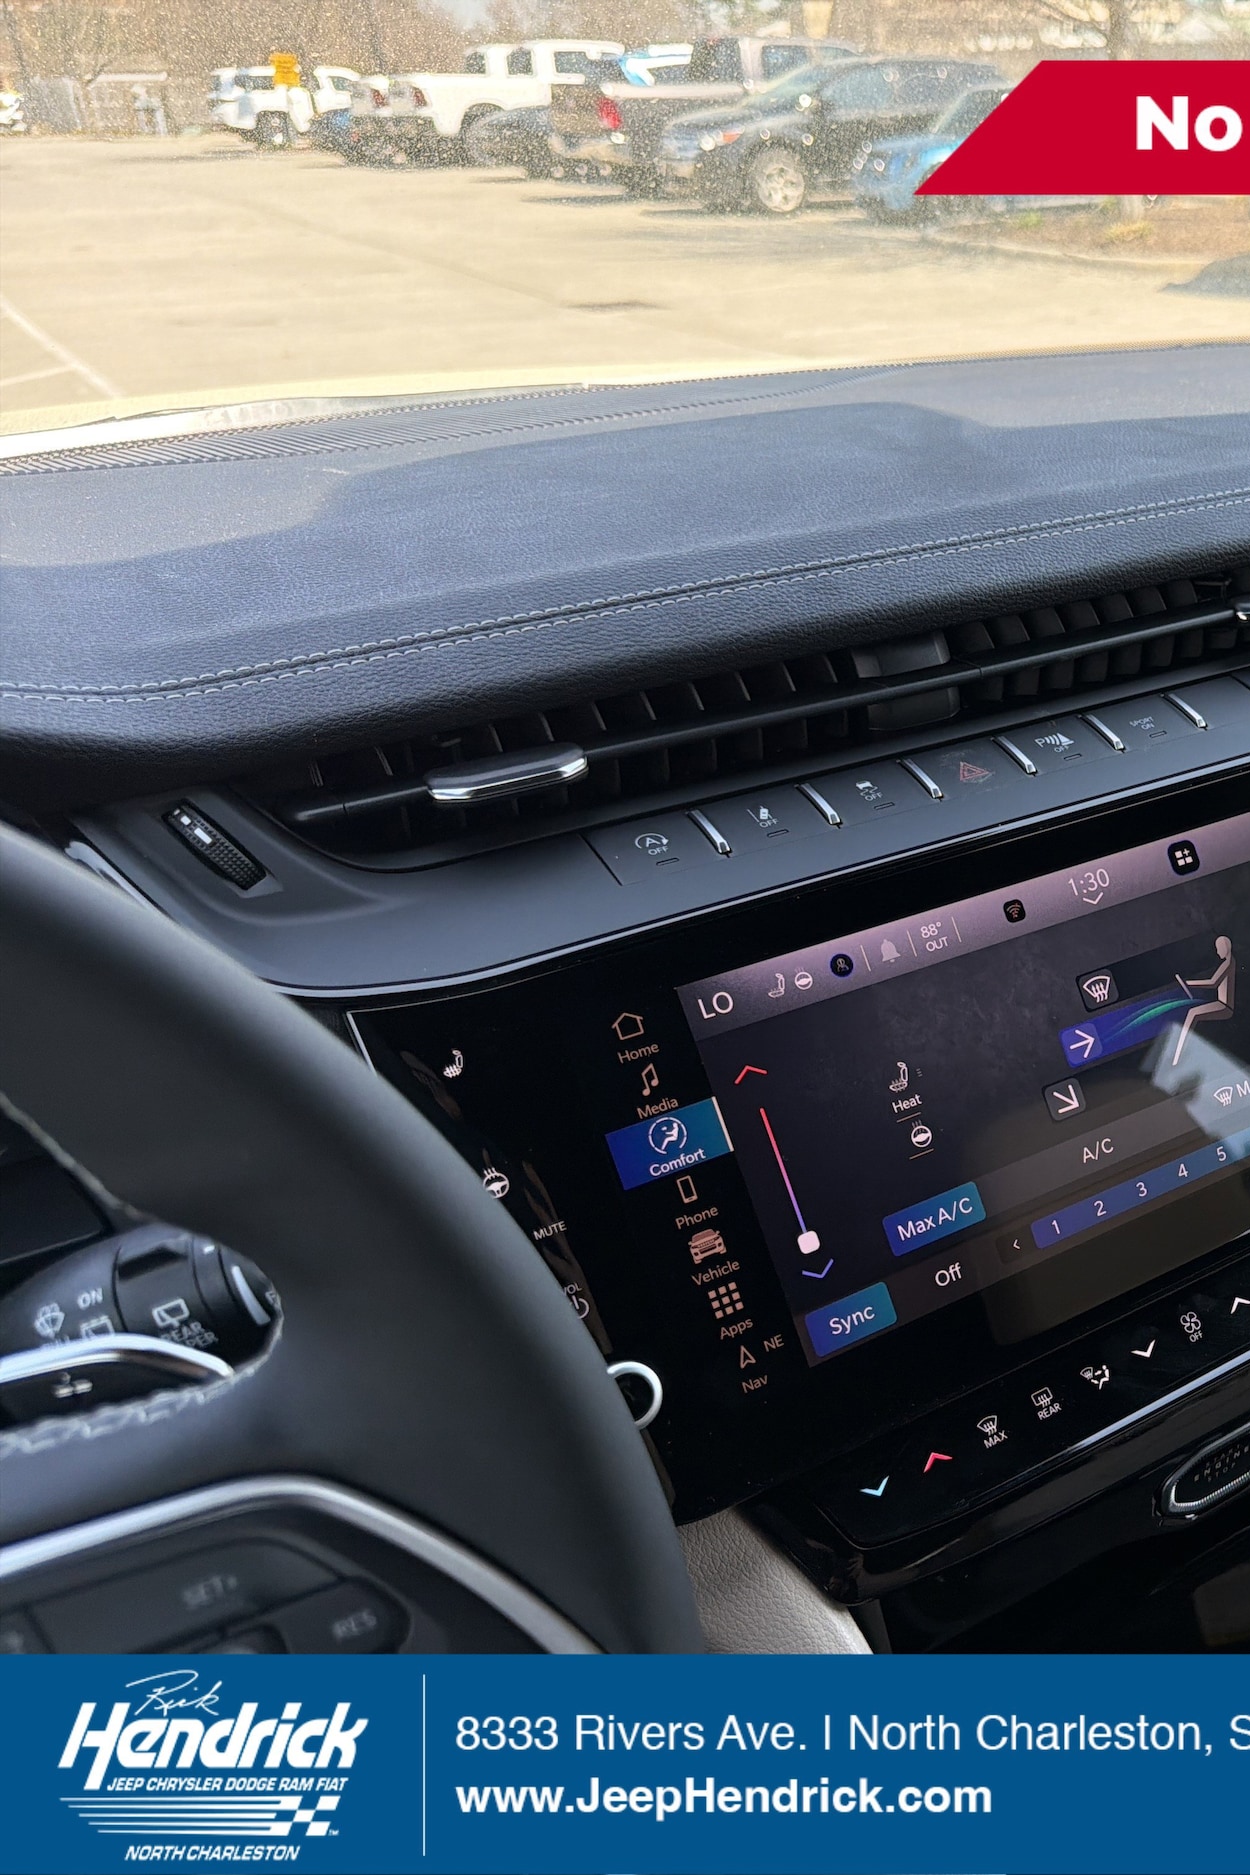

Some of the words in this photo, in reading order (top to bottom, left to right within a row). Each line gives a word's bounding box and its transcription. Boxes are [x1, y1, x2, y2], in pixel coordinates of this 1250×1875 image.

[1129, 716, 1155, 728] SPORT
[1141, 722, 1156, 731] ON
[1053, 745, 1070, 753] OFF
[864, 791, 883, 801] OFF
[758, 818, 779, 829] OFF
[647, 845, 669, 856] OFF
[1068, 867, 1111, 898] 1:30
[925, 936, 948, 952] OUT
[698, 991, 734, 1020] LO
[617, 1042, 660, 1064] Home
[636, 1096, 679, 1120] Media
[892, 1093, 923, 1114] Heat
[1082, 1137, 1115, 1164] A/C
[648, 1147, 707, 1178] Comfort
[1051, 1219, 1061, 1235] 1
[1093, 1200, 1107, 1217] 2
[1135, 1181, 1148, 1197] 3
[1177, 1162, 1189, 1179] 4
[1216, 1146, 1228, 1162] 5
[675, 1204, 719, 1230] Phone
[896, 1213, 937, 1242] Max
[937, 1197, 974, 1227] A/C
[533, 1220, 568, 1241] MUTE
[691, 1258, 741, 1287] Vehicle
[934, 1262, 964, 1287] Off
[77, 1287, 104, 1310] ON
[719, 1316, 754, 1341] Apps
[828, 1304, 876, 1337] Sync
[764, 1334, 786, 1352] NE
[1188, 1329, 1203, 1343] OFF
[742, 1373, 769, 1394] Nav
[1036, 1402, 1062, 1420] REAR
[983, 1429, 1009, 1449] MAX
[1193, 1444, 1250, 1482] ENGINE
